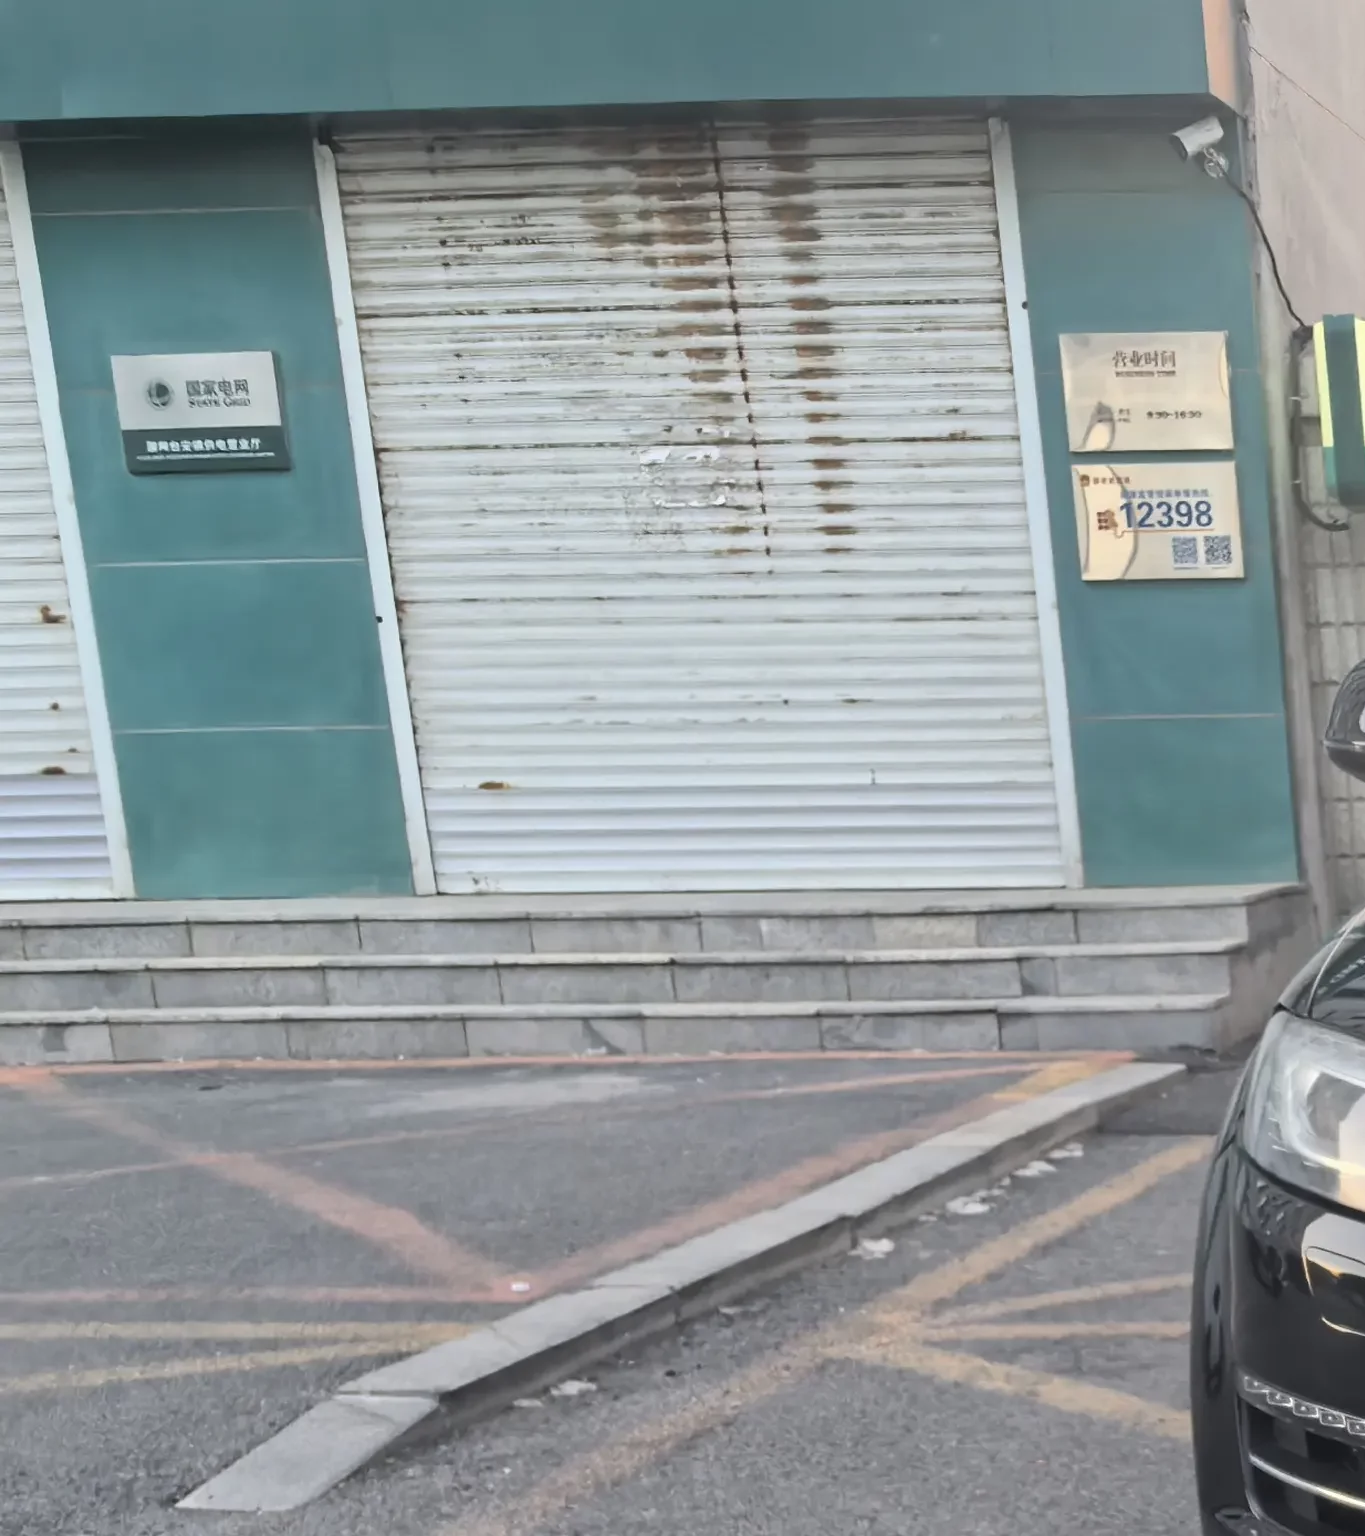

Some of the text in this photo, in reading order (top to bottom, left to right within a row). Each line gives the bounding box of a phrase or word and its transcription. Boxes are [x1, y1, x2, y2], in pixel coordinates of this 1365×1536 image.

[1112, 350, 1176, 368] 营业时间
[186, 377, 250, 397] 国家电网
[1119, 500, 1214, 529] 12398
